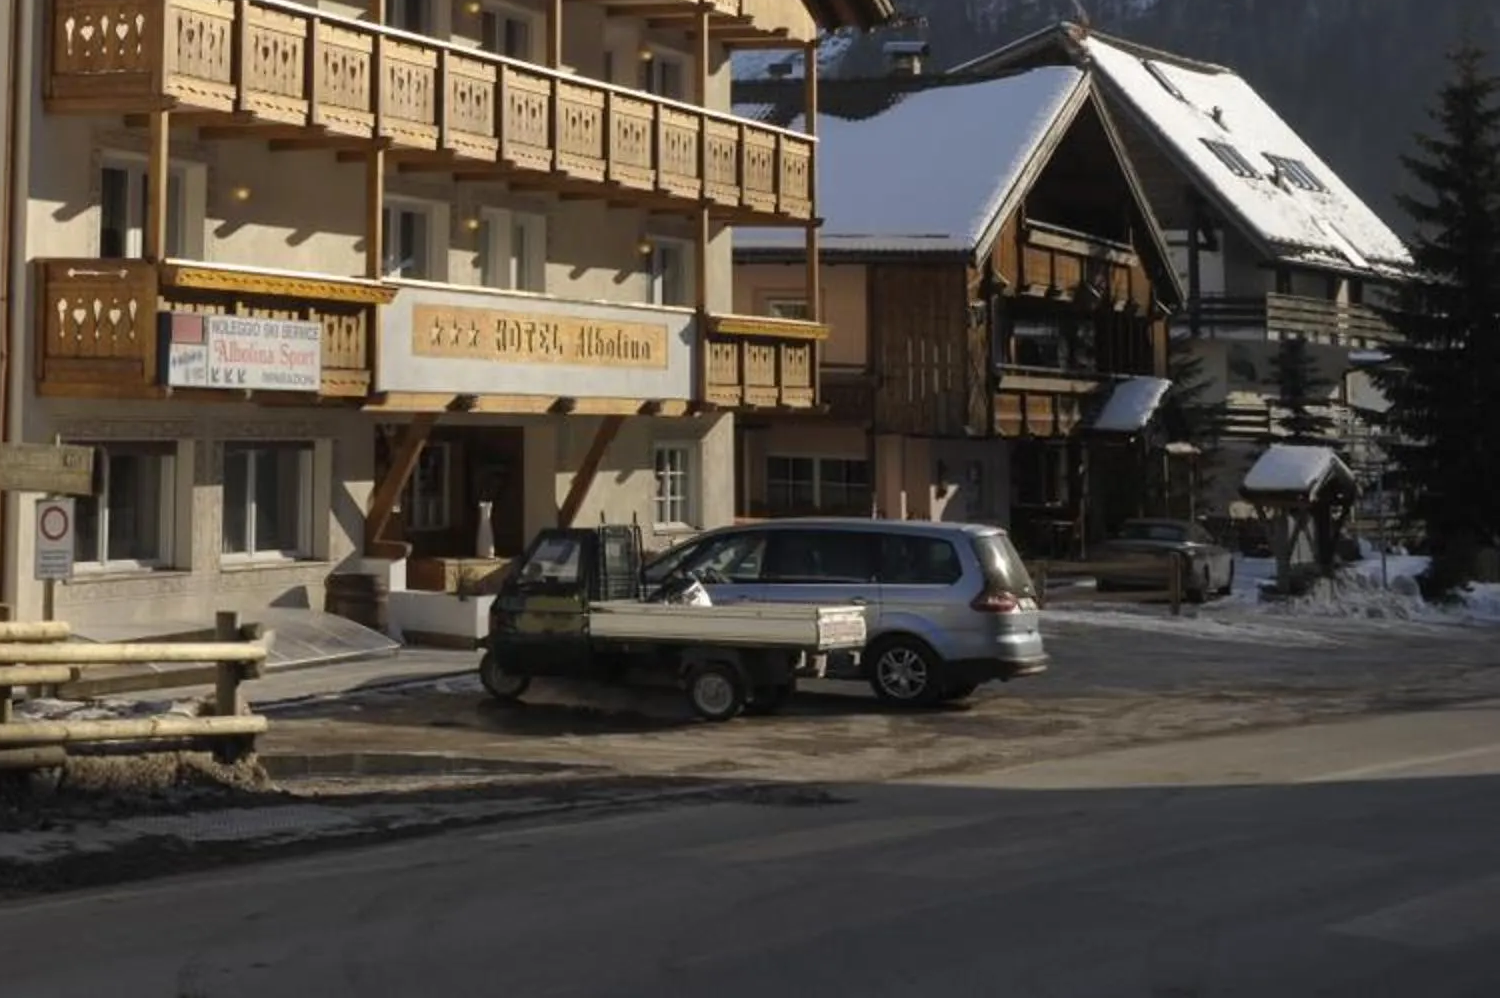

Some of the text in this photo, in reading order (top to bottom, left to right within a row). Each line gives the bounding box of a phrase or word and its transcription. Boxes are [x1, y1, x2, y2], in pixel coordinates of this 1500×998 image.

[212, 320, 319, 340] NOLEGGIO SKI SERVICE
[495, 318, 651, 360] HOTEL Albolina
[214, 339, 275, 364] Albolina
[280, 343, 316, 370] Sport
